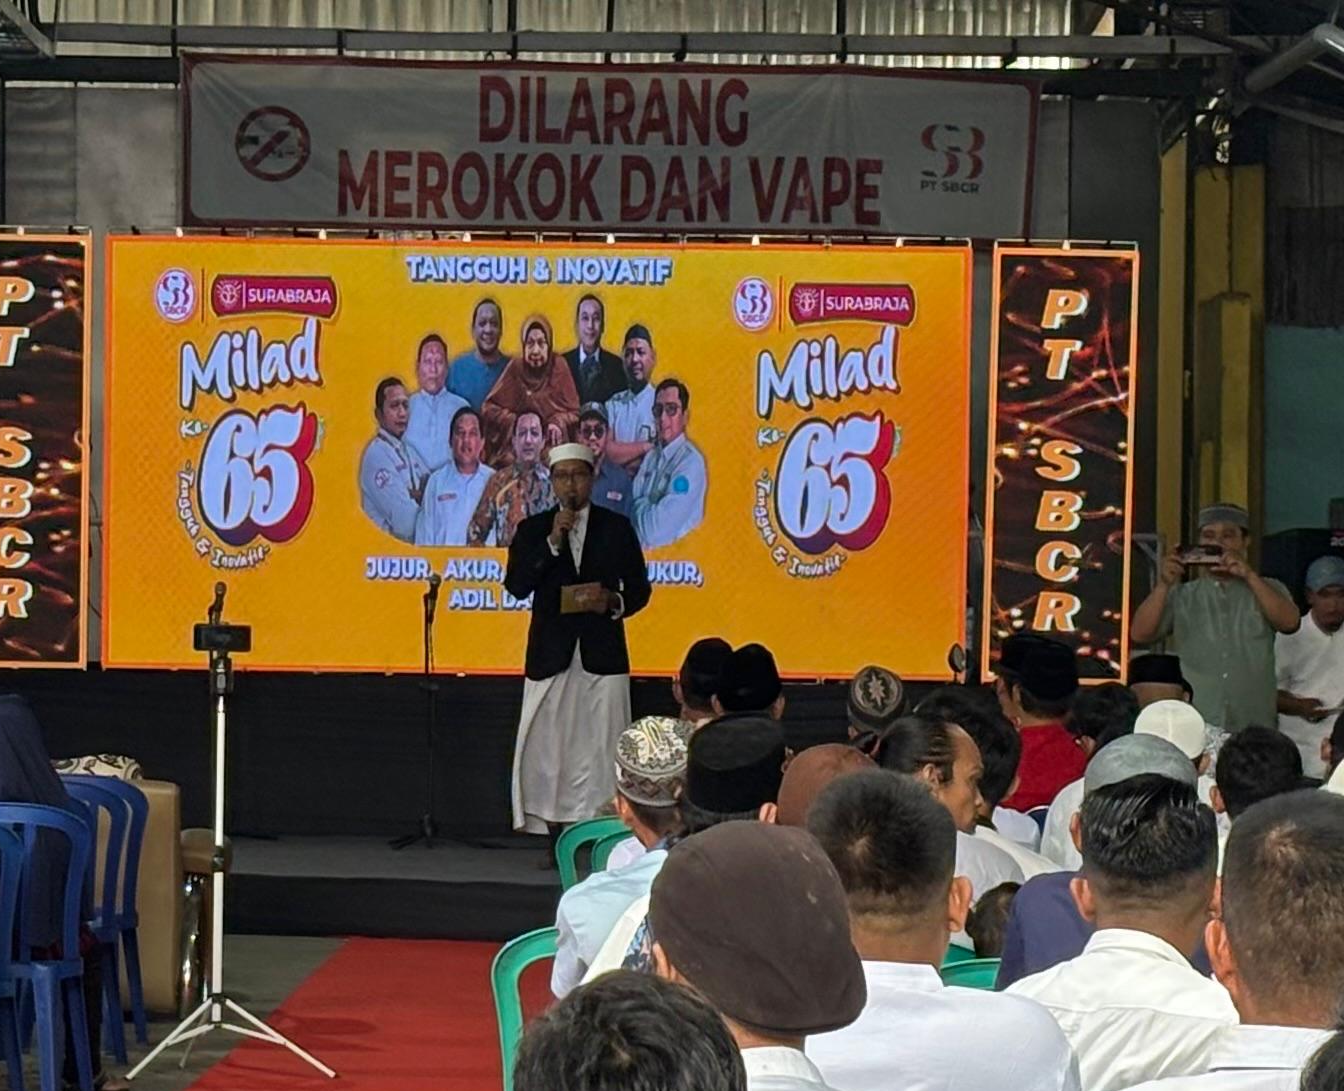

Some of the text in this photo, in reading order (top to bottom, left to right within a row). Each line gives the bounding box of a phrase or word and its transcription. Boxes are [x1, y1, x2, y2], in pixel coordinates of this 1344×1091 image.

[477, 75, 750, 147] DILARANG
[337, 149, 884, 227] MEROKOK DAN VAPE
[920, 180, 980, 194] PT SBCR
[247, 287, 332, 305] SURABRAJA
[406, 255, 673, 286] TANGGUH & INOVATIF
[825, 295, 910, 311] SURABRAJA
[180, 316, 322, 410] Milad
[757, 324, 899, 420] Milad
[200, 404, 311, 536] 65
[777, 412, 887, 544] 65
[1032, 288, 1088, 633] PT SBCR
[195, 538, 212, 557] &
[772, 545, 789, 565] &
[448, 588, 498, 610] ADIL
